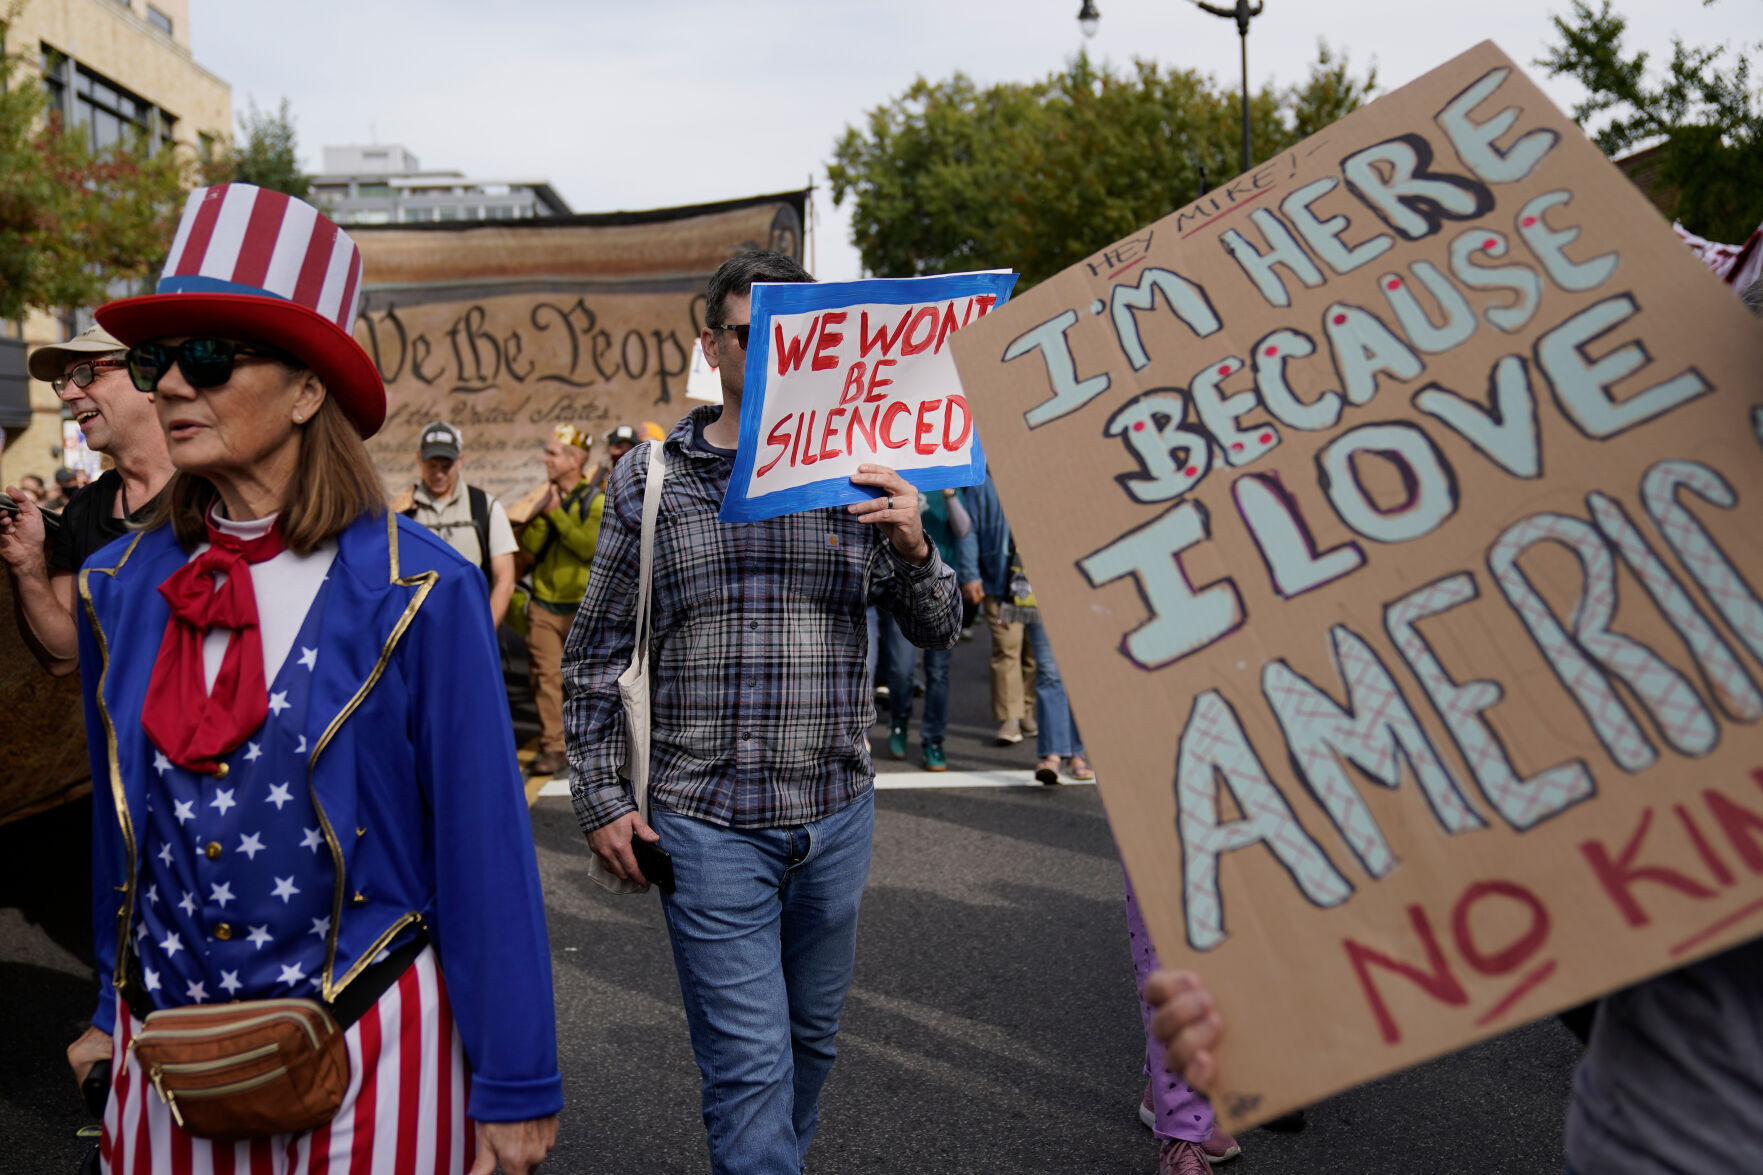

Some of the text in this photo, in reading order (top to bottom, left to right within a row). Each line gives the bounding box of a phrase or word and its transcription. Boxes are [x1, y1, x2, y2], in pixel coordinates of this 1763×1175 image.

[1002, 66, 1561, 430] I'M HERE
[1086, 152, 1297, 277] HEY MIKE!
[355, 296, 708, 406] We the Peop
[774, 311, 848, 377] WE
[839, 358, 897, 406] BE
[1103, 190, 1620, 504] BECAUSE
[756, 394, 974, 478] SILENCED
[1076, 292, 1718, 672] I LOVE
[1174, 403, 1763, 952] AMERIC
[1341, 879, 1553, 1047] NO
